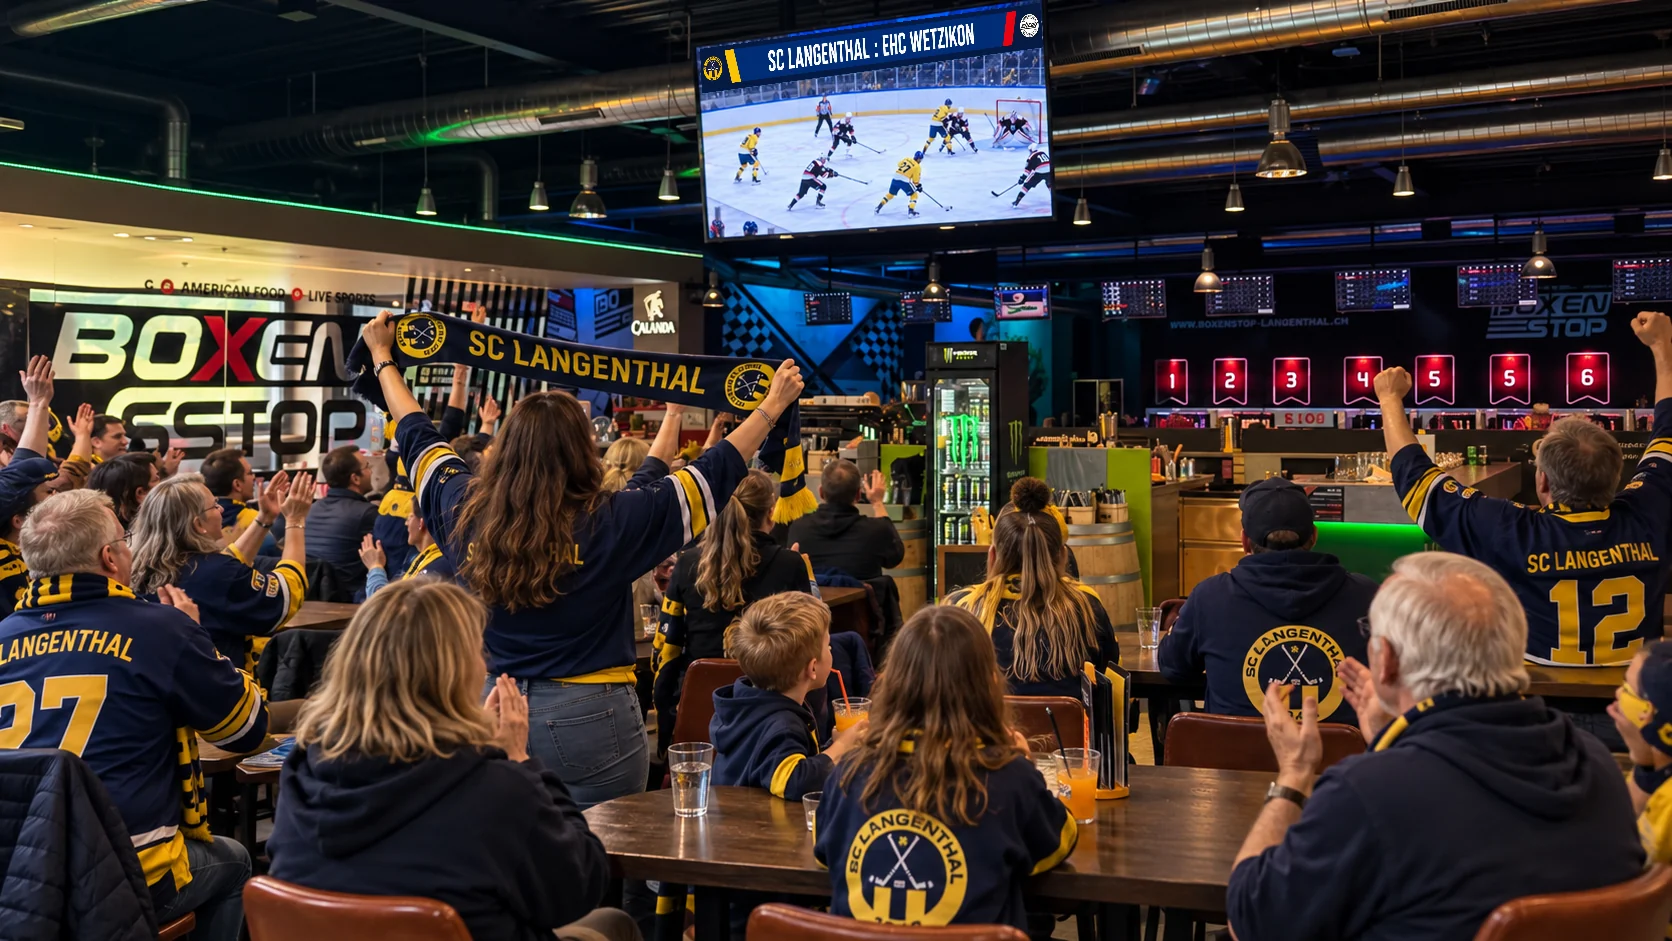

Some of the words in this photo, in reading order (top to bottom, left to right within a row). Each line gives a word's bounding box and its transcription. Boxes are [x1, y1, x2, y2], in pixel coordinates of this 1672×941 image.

[767, 48, 785, 72] SC
[788, 38, 871, 70] LANGENTHAL
[882, 32, 907, 57] EHC
[909, 23, 975, 53] WETZIKON
[180, 281, 250, 298] AMERICAN
[253, 286, 286, 299] FOOD
[308, 290, 331, 303] LIVE
[335, 292, 376, 306] SPORTS
[630, 319, 676, 337] CALANDA
[1527, 318, 1608, 339] STOP
[468, 329, 505, 361] SC
[513, 338, 706, 395] LANGENTHAL
[1169, 373, 1175, 389] 1
[1225, 372, 1235, 388] 2
[1286, 371, 1297, 388] 3
[1357, 371, 1369, 388] 4
[1428, 370, 1441, 387] 5
[1503, 369, 1516, 387] 5
[1580, 368, 1594, 386] 6
[1527, 552, 1551, 573] SC
[1555, 542, 1659, 571] LANGENTHAL
[1549, 575, 1646, 665] 12
[0, 629, 134, 666] LANGENTHAL
[1246, 656, 1259, 678] SC
[1253, 628, 1343, 677] LANGENTHA
[849, 846, 862, 874] SC
[858, 813, 964, 885] LANGENTHAL
